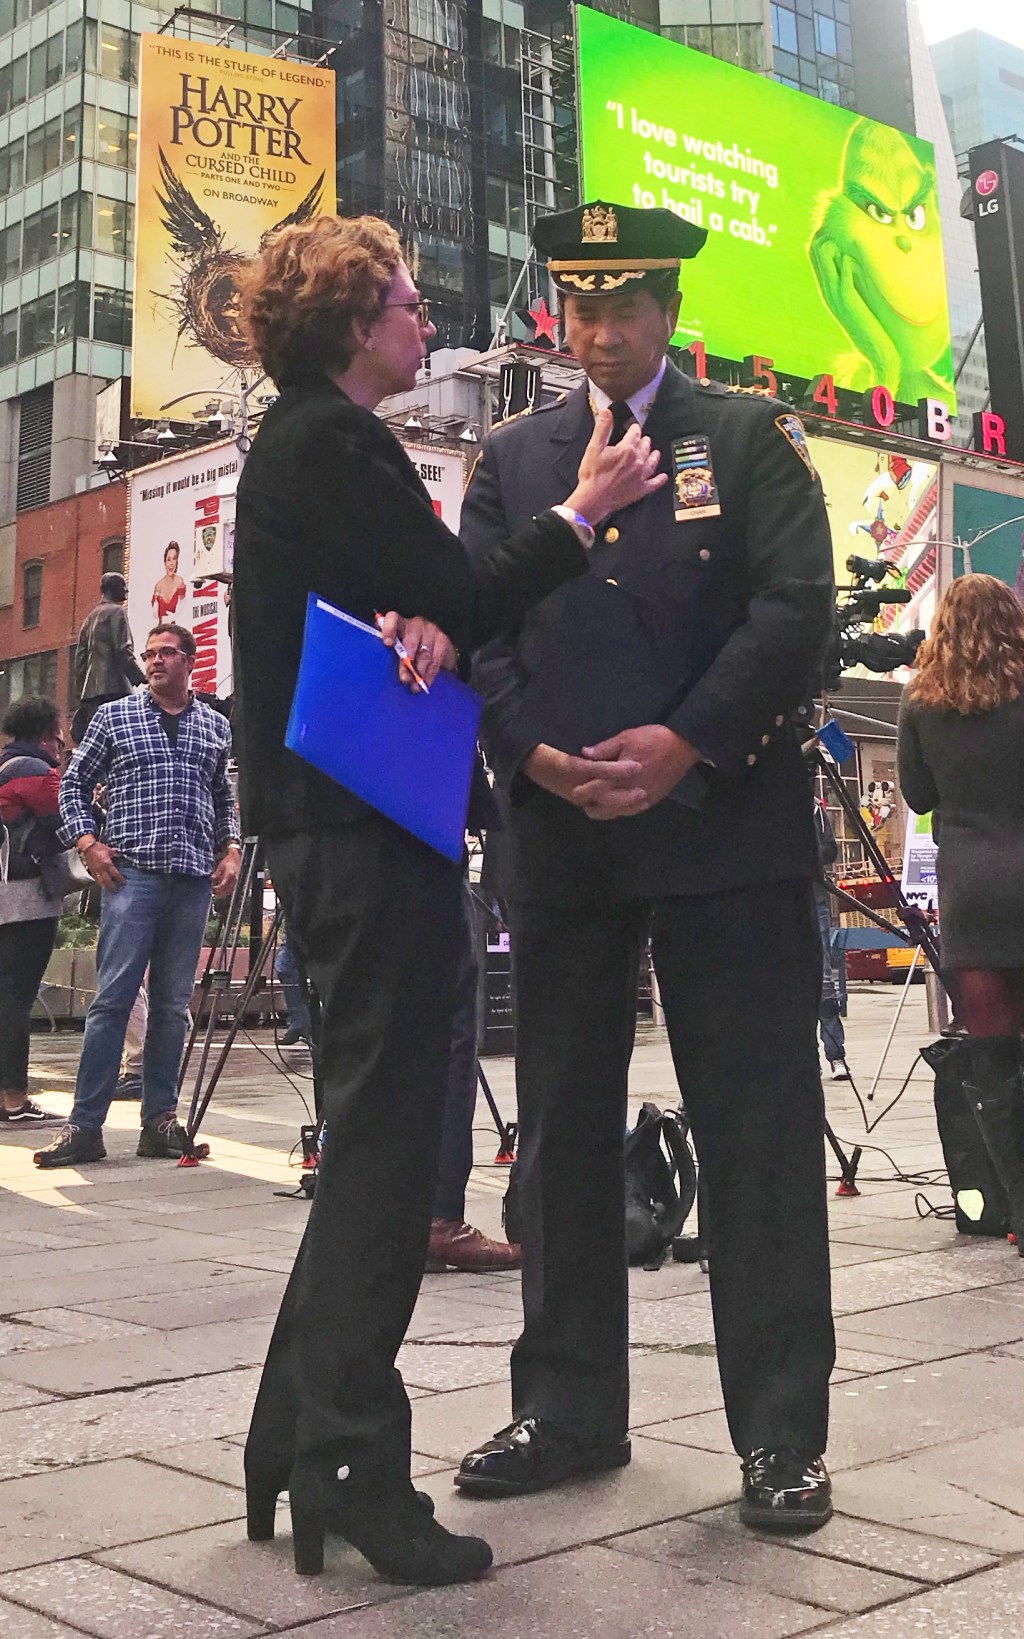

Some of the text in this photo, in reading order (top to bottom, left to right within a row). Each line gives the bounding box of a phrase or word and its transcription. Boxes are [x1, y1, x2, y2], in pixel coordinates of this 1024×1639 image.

[184, 52, 195, 62] IS
[197, 54, 221, 67] THE
[224, 58, 259, 75] STUFF
[261, 67, 277, 78] OF
[179, 72, 303, 130] HARRY
[169, 105, 312, 166] POTTER
[605, 100, 779, 188] "I love watching
[185, 154, 297, 185] CURSED CHILD
[220, 152, 260, 165] AND THE
[201, 172, 281, 191] PARTS ONE AND TWO
[643, 150, 760, 215] tourists try
[203, 188, 279, 208] ON BROADWAY
[632, 182, 656, 209] to
[709, 212, 723, 232] a
[978, 198, 999, 217] LG
[166, 482, 171, 494] it
[172, 476, 190, 493] would
[191, 474, 199, 486] be
[200, 472, 205, 483] a
[206, 467, 216, 482] big
[906, 892, 928, 900] NYC
